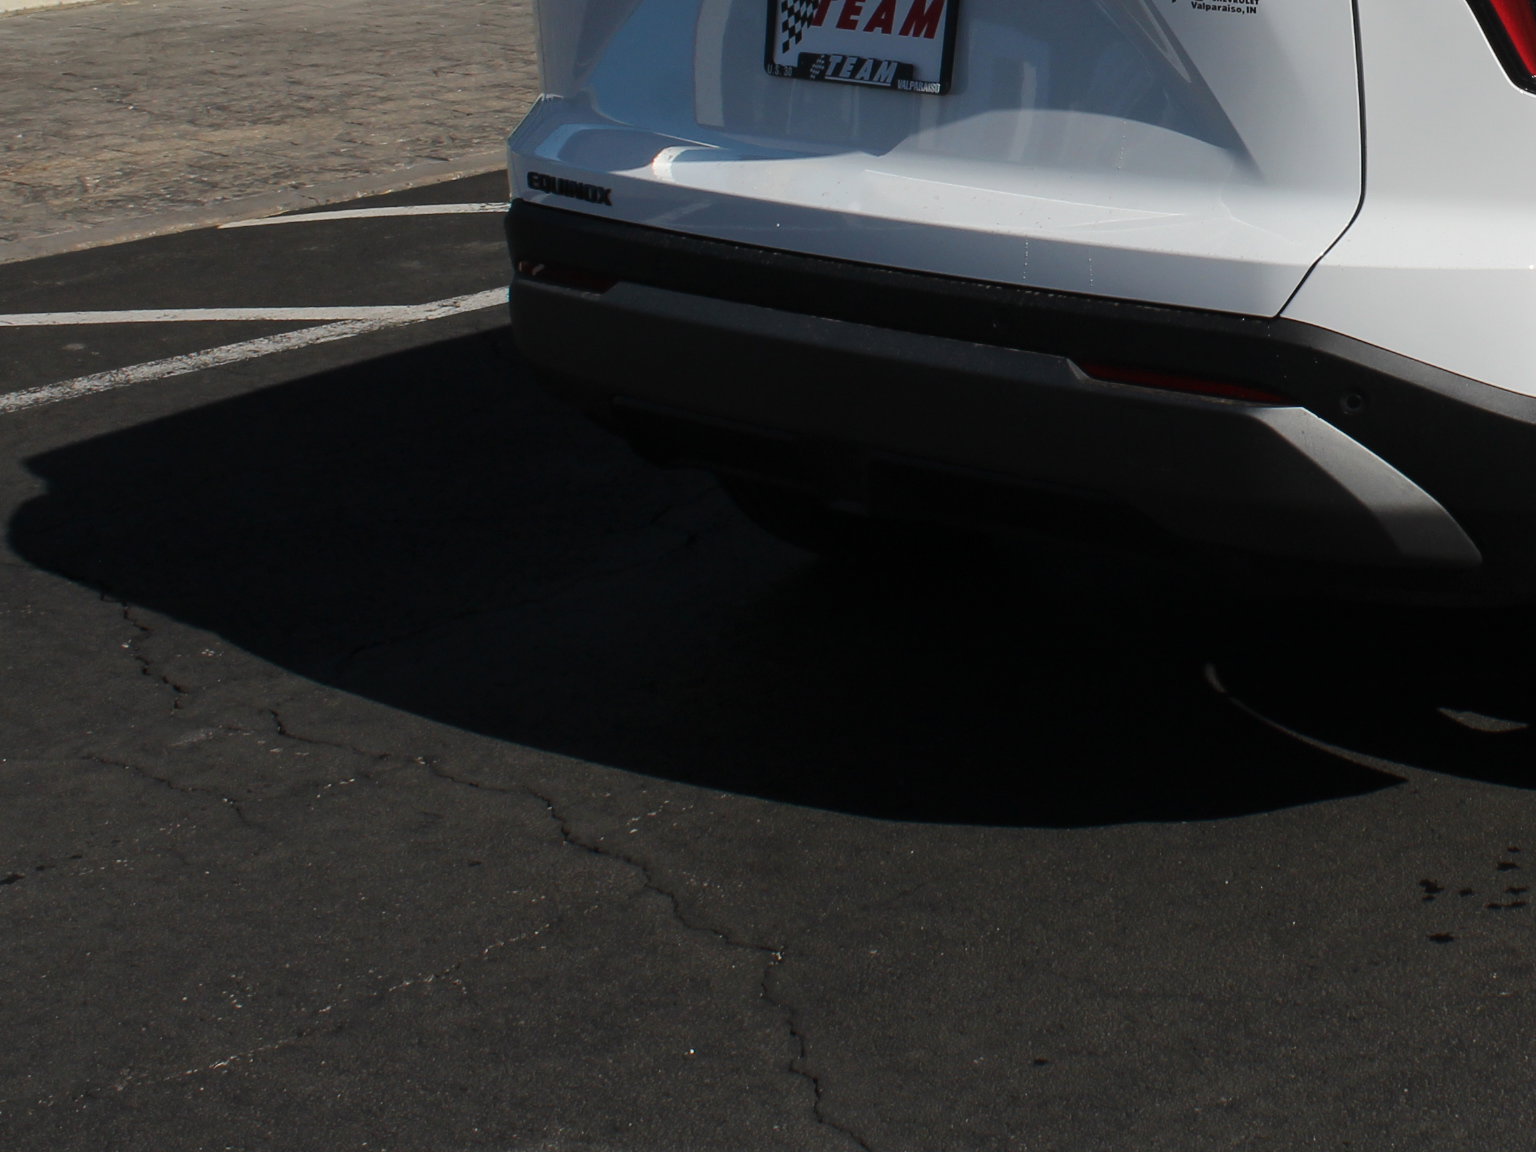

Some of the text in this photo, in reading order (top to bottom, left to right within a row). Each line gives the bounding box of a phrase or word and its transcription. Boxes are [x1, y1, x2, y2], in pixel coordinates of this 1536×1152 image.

[1191, 1, 1257, 14] Valparaiso, IN
[767, 64, 781, 76] U.S.
[825, 54, 899, 83] TEAM
[897, 79, 942, 94] VALPARAISO
